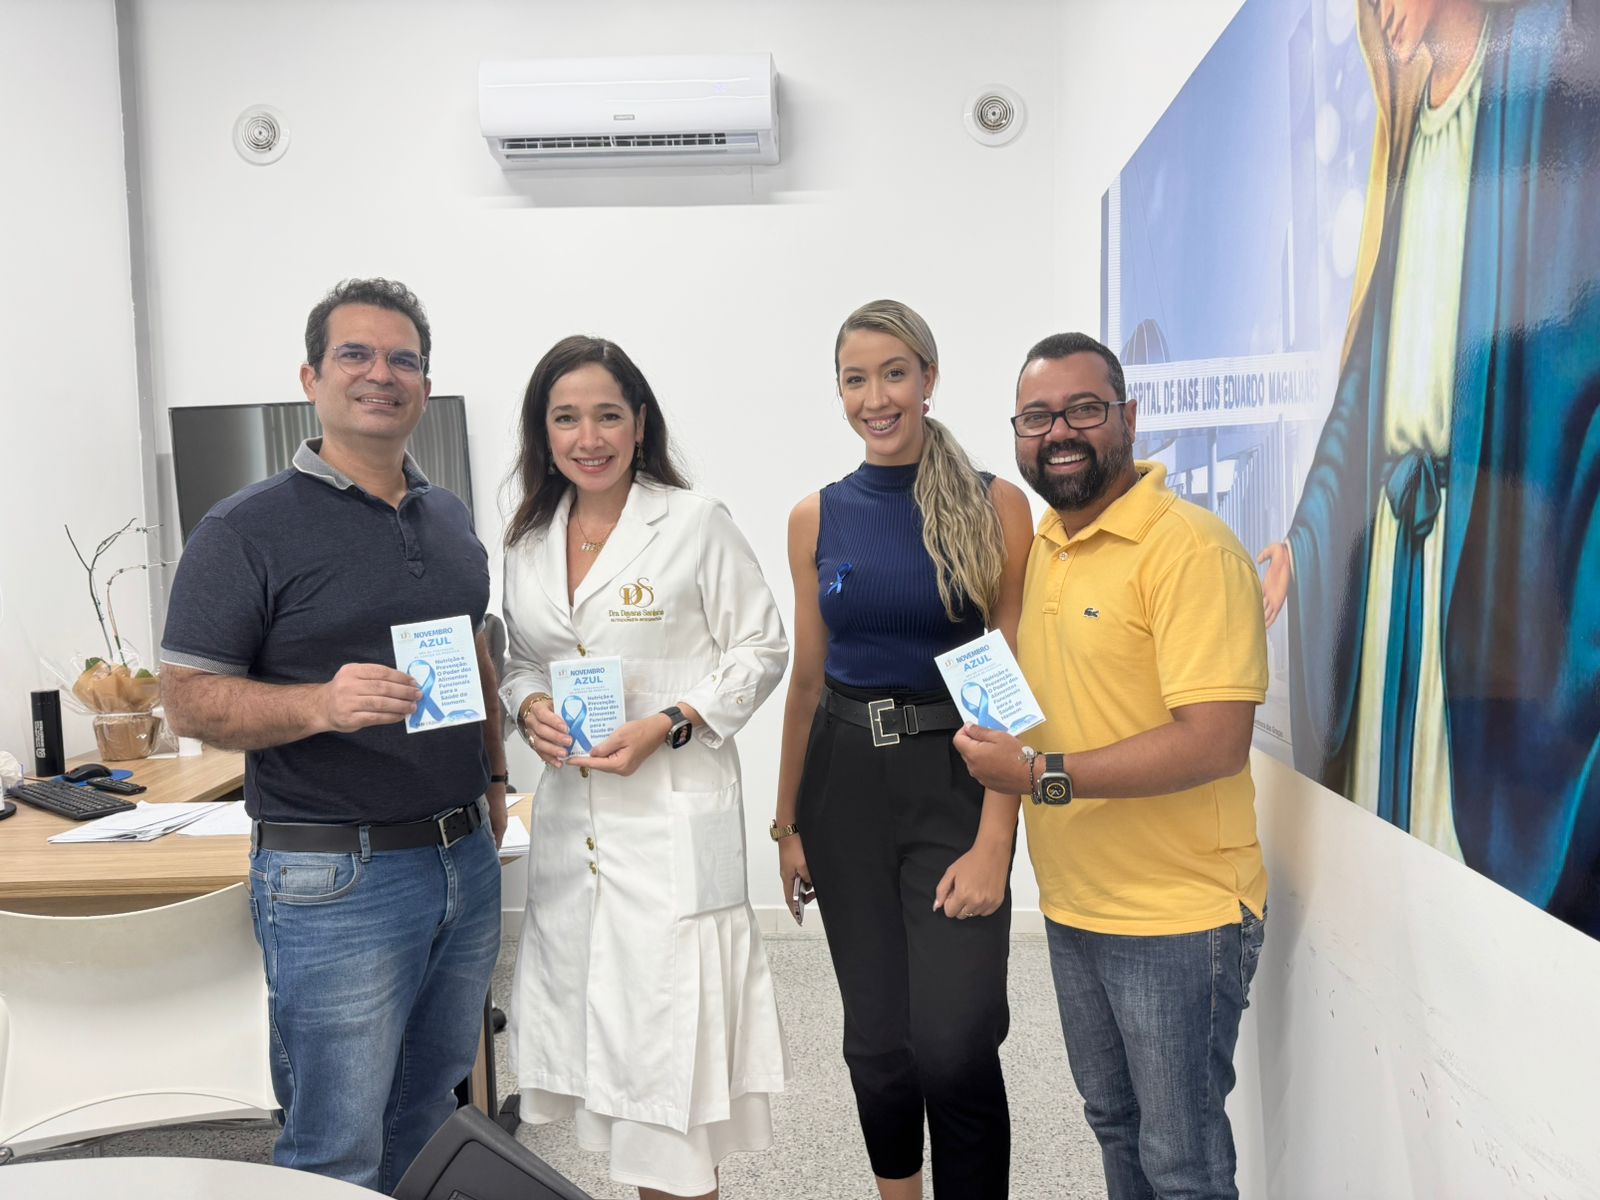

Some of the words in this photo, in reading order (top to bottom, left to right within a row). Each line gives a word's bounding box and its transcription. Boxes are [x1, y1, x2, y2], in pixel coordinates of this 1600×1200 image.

[1126, 381, 1161, 416] OSPITAL
[1164, 380, 1174, 415] DE
[1177, 377, 1199, 413] BASE
[1202, 375, 1220, 411] LUIS
[1223, 372, 1265, 410] EDUARDO
[414, 628, 453, 638] NOVEMBRO
[419, 636, 452, 648] AZUL
[956, 644, 990, 663] NOVEMBRO
[964, 654, 992, 671] AZUL
[570, 667, 605, 676] NOVEMBRO
[574, 676, 603, 685] AZUL
